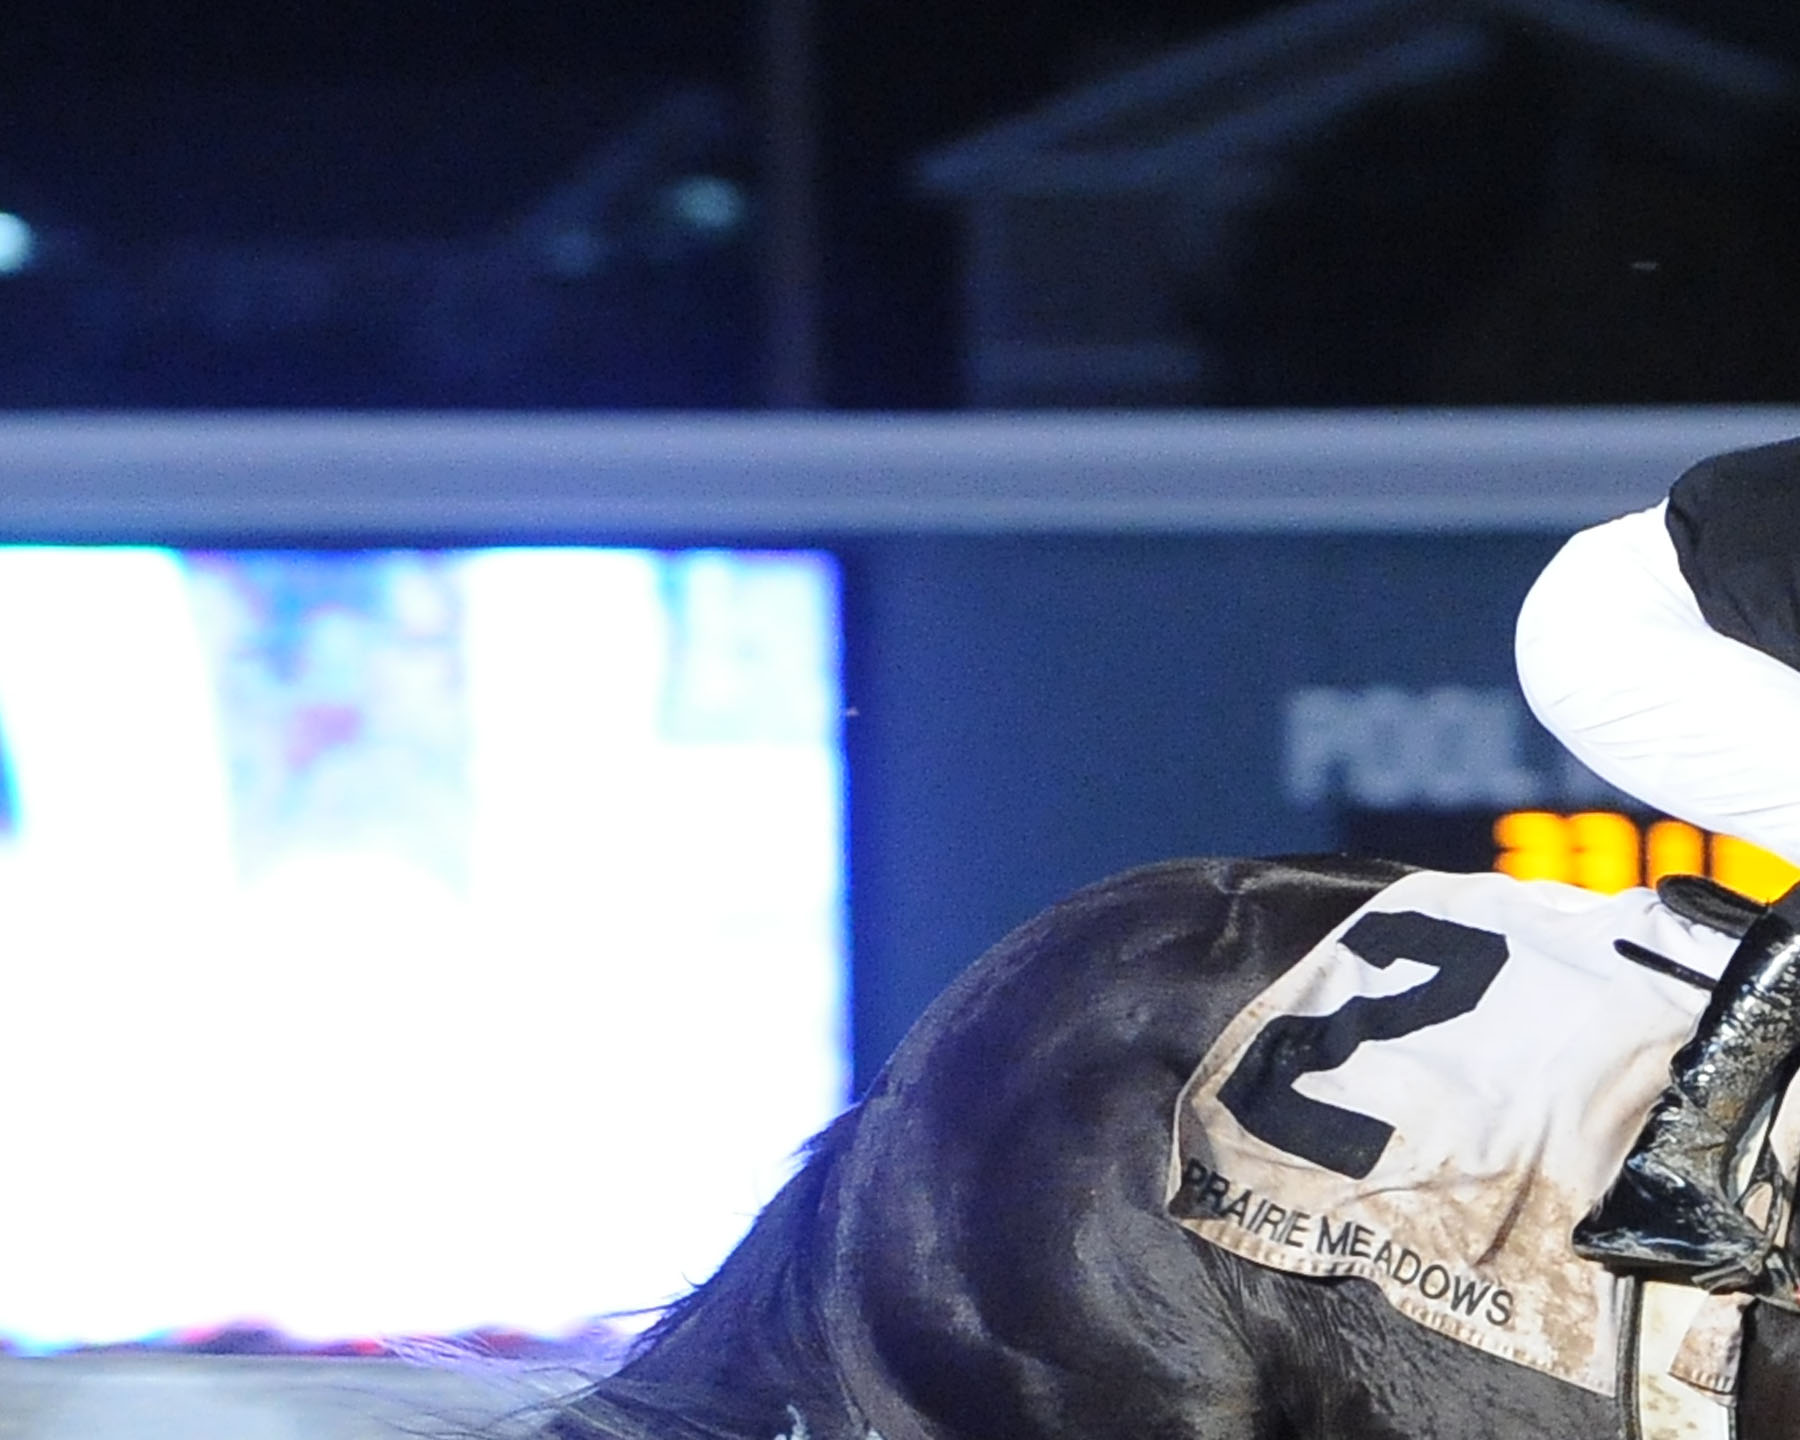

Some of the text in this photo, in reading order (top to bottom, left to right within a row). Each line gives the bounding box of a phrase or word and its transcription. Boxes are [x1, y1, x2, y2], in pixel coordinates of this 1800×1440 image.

[1216, 910, 1509, 1180] 2
[1181, 1157, 1514, 1327] PRAIRIE MEADOWS
